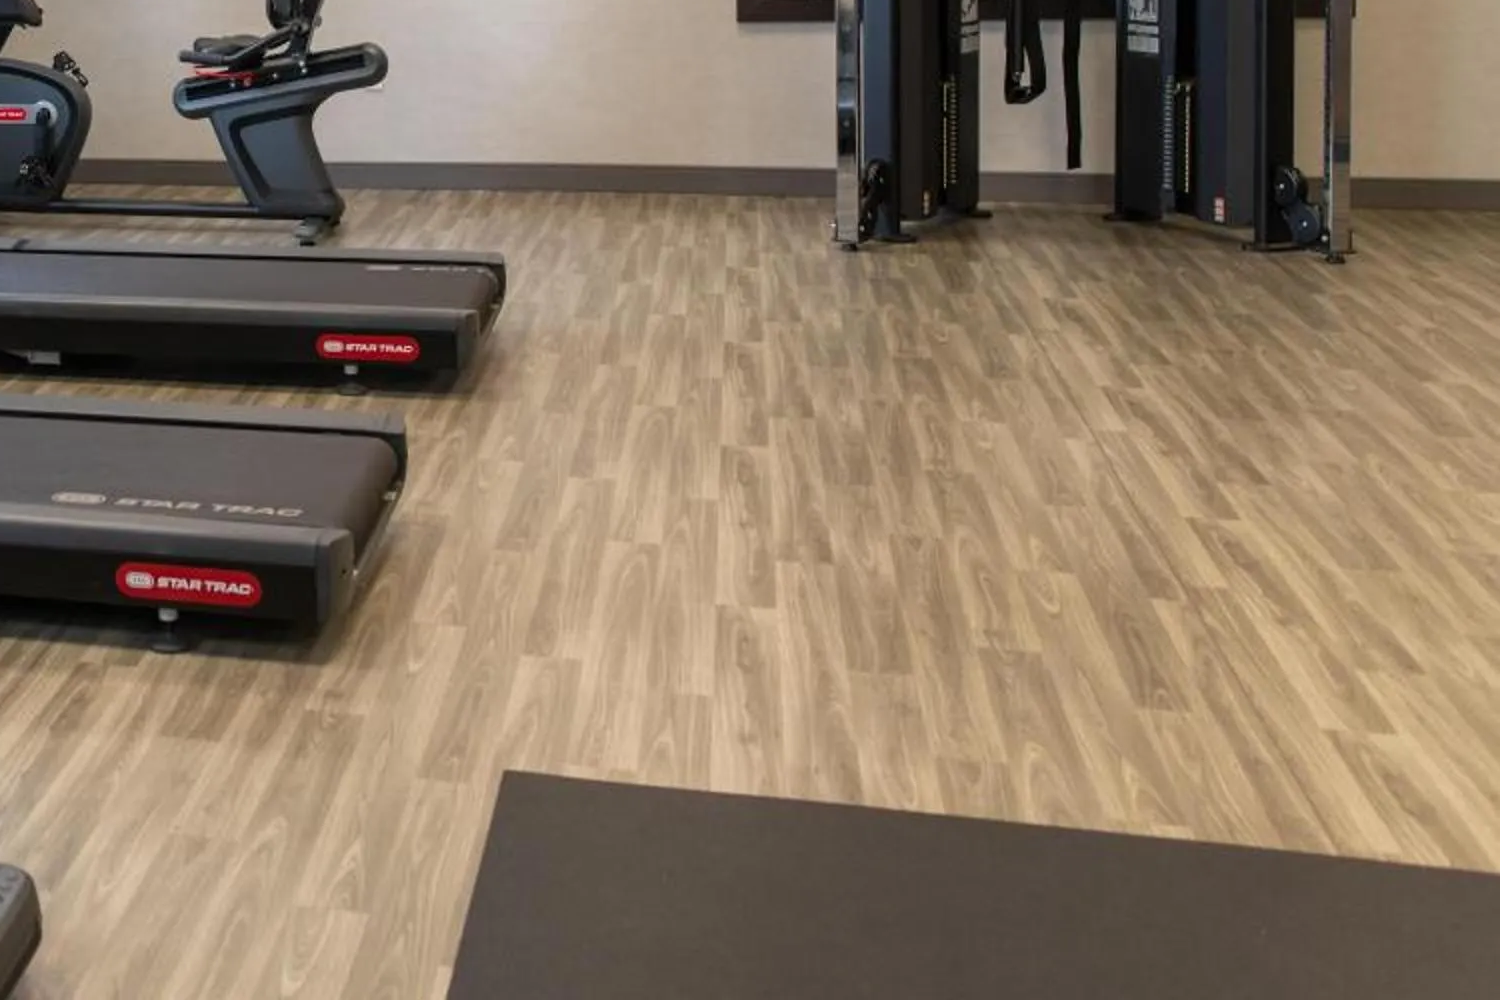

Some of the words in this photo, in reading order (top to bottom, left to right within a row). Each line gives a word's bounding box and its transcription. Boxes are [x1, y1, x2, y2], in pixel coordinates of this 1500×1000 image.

[114, 498, 200, 510] STAR
[212, 503, 303, 517] TRAC
[157, 576, 202, 592] STAR
[204, 580, 253, 595] TRAC
